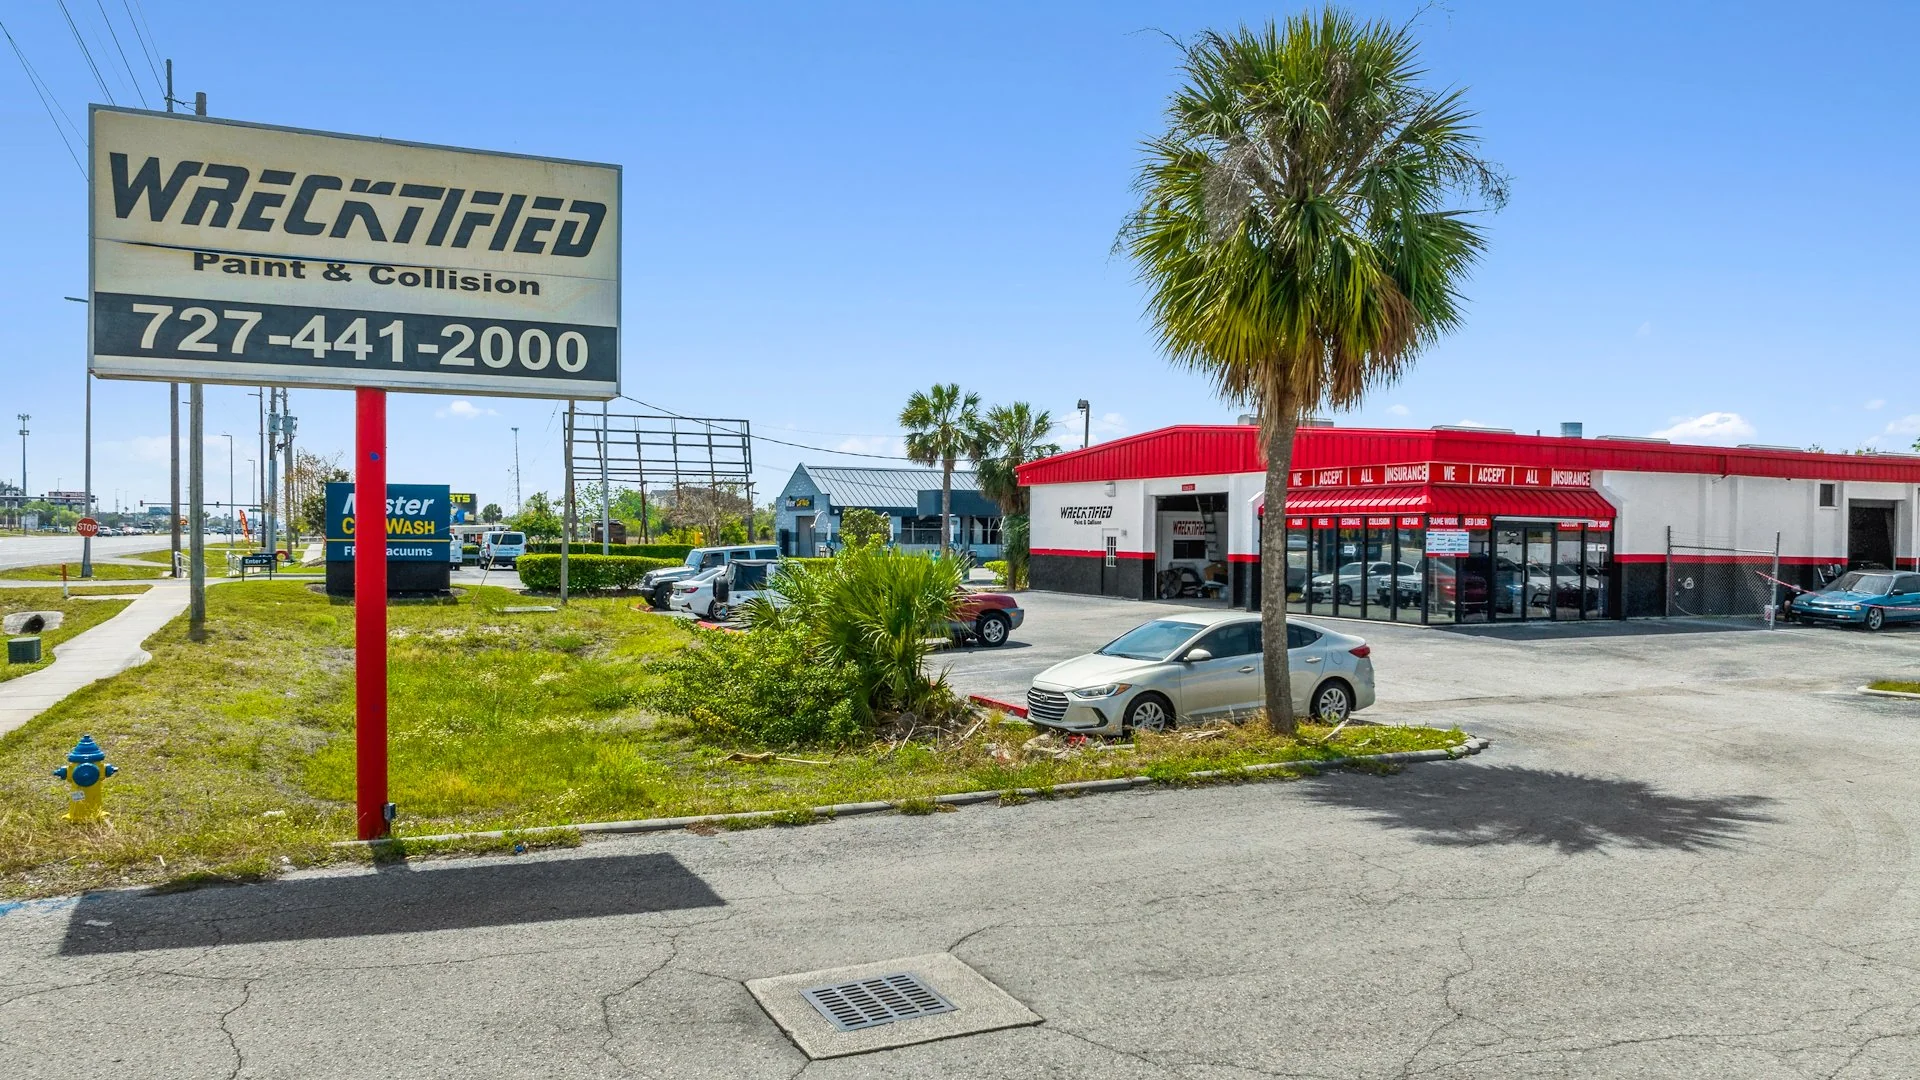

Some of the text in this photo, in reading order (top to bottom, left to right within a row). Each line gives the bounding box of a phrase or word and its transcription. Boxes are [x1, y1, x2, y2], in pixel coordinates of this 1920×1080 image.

[109, 152, 607, 257] WRECKTIFIED
[194, 252, 541, 296] Paint & Collision
[132, 303, 589, 373] 727-441-2000
[1293, 466, 1427, 486] WE ACCEPT ALL INSURANCE
[1444, 466, 1590, 486] WE ACCEPT ALL INSURANCE
[343, 493, 435, 515] ster
[1060, 506, 1113, 519] WRECKTIFIED
[1291, 518, 1303, 526] PAINT
[1318, 518, 1329, 526] FREE
[1341, 517, 1361, 525] ESTIMATE
[1368, 517, 1391, 525] COLLISION
[1402, 517, 1419, 525] REPAIR
[1444, 517, 1459, 525] WORK
[1464, 518, 1488, 526] BED LINER
[1599, 520, 1610, 528] SHOP
[77, 522, 98, 532] STOP
[386, 518, 435, 535] WASH
[386, 548, 433, 556] acuums
